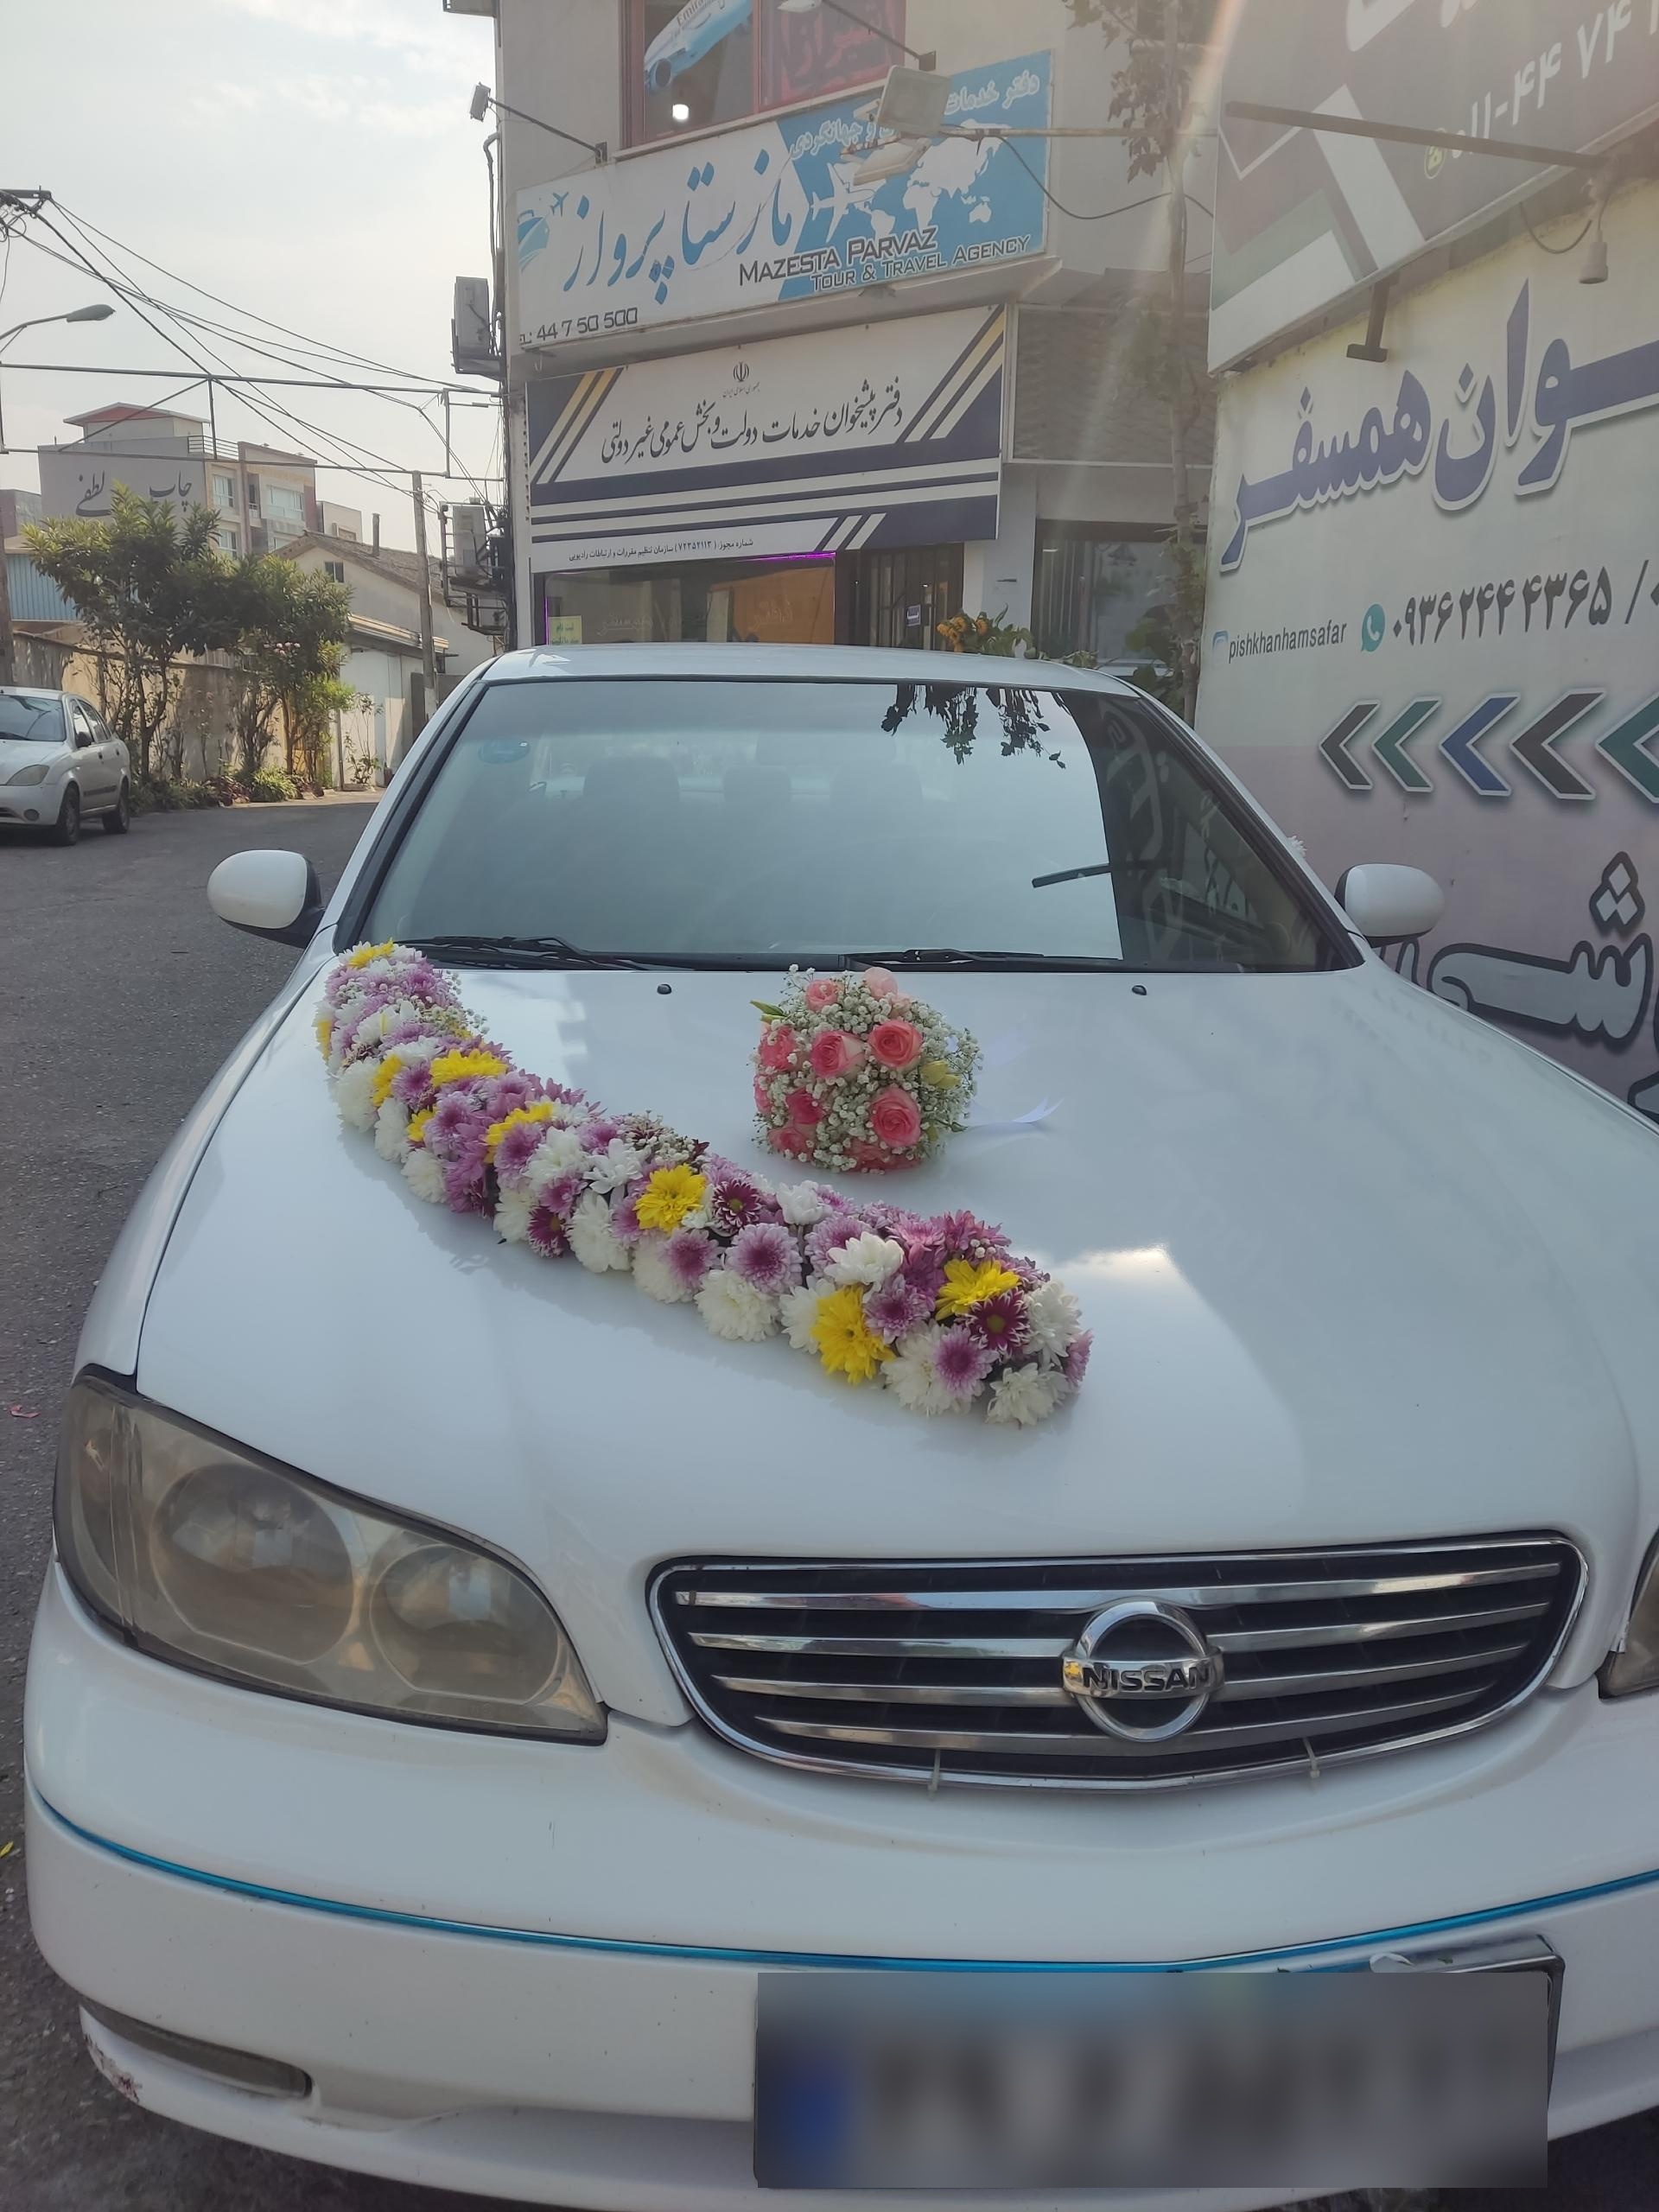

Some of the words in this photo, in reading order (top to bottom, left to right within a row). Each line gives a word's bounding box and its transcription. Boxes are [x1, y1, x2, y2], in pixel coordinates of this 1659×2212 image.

[1001, 70, 1039, 109] دفتر
[563, 194, 675, 305] پرواز
[739, 249, 841, 287] MAZESTA
[848, 228, 938, 264] PARVAZ
[813, 270, 855, 292] TOUR
[861, 265, 876, 283] &
[883, 254, 947, 278] TRAVEL
[953, 236, 1032, 264] AGENCY
[604, 307, 638, 329] 500
[681, 399, 716, 454] بخش
[762, 408, 821, 442] خدمات
[823, 378, 877, 436] پیشخوان
[868, 375, 903, 435] دفتر
[601, 418, 629, 464] دولتی
[625, 416, 653, 465] غیر
[650, 420, 685, 459] عمومی
[710, 410, 758, 449] دولت
[1219, 369, 1434, 574] همسفر
[653, 544, 673, 556] سازمان
[718, 541, 734, 551] مجوز
[736, 538, 753, 550] شماره
[1228, 619, 1348, 664] pishkhanhamsafar
[1082, 1666, 1210, 1691] NISSAN
